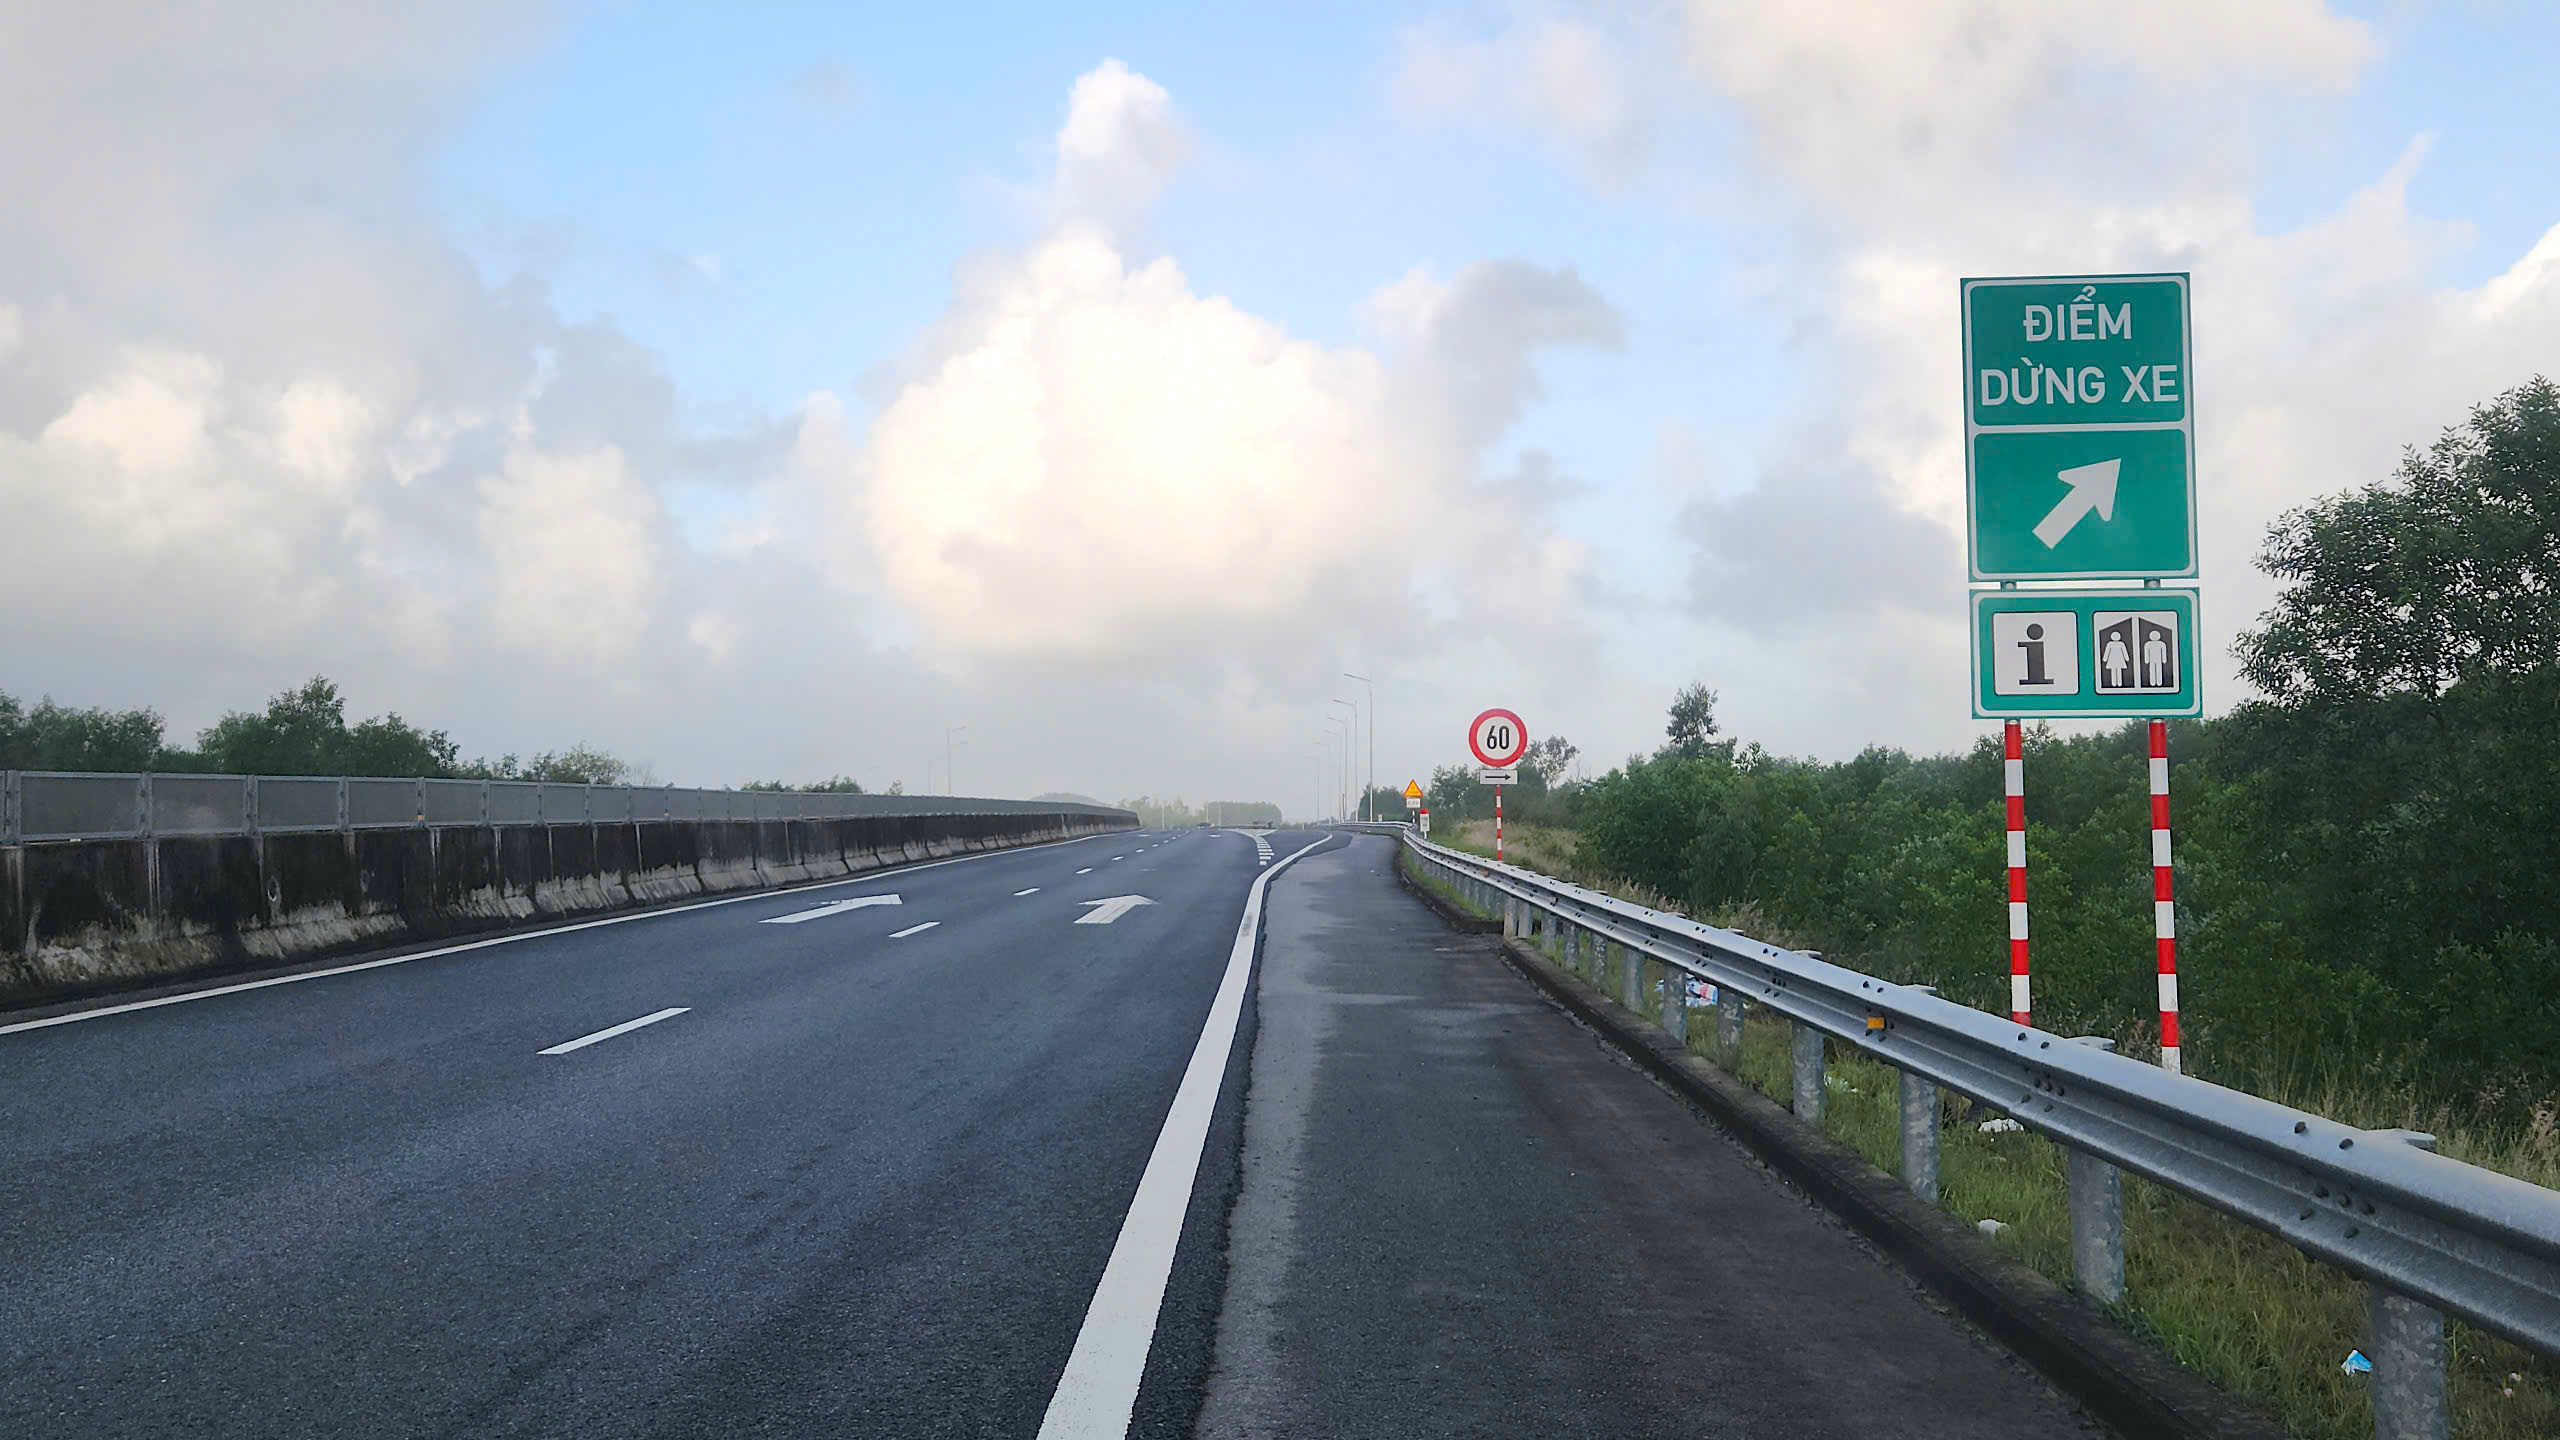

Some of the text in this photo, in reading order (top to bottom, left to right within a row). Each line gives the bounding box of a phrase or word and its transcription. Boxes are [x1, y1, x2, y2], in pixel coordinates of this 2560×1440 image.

[2023, 285, 2132, 342] ĐIỂM
[1980, 356, 2179, 406] DỪNG XE
[1486, 725, 1510, 750] 60
